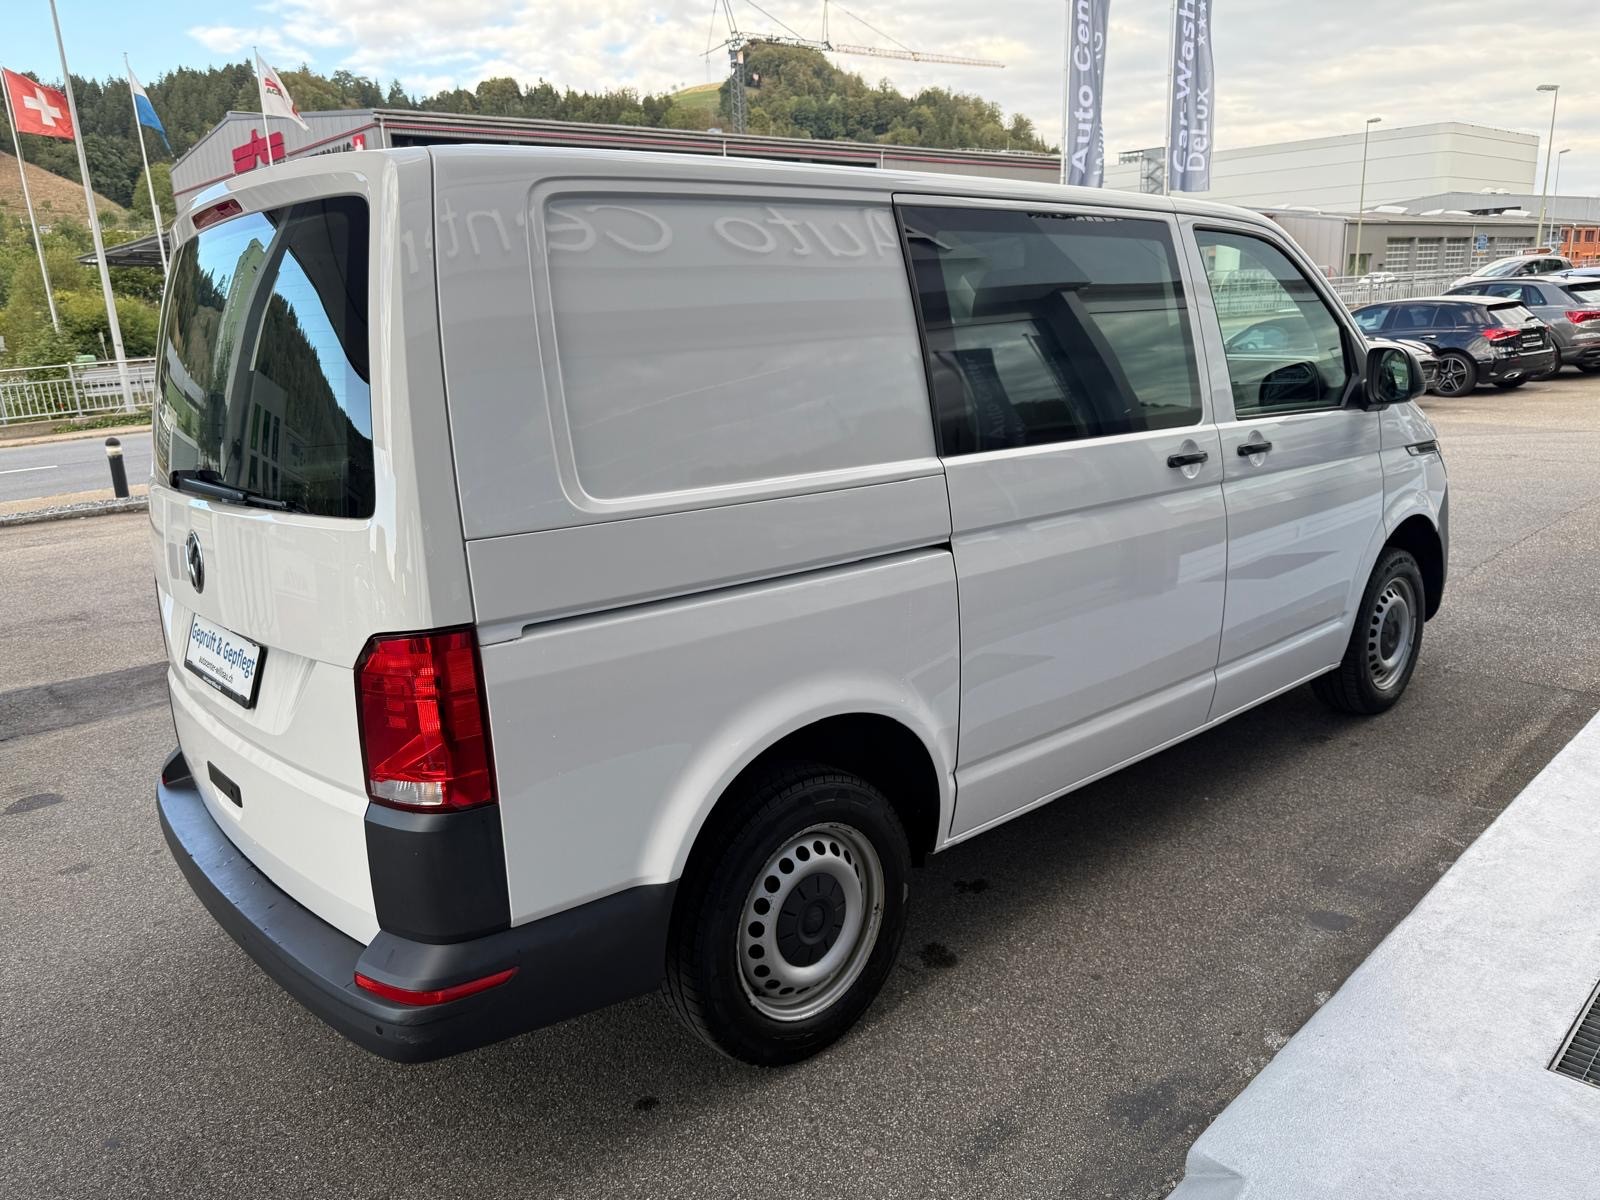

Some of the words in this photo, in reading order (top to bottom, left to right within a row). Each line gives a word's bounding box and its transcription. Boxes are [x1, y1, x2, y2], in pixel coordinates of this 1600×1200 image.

[1071, 84, 1094, 174] Auto
[1173, 0, 1195, 173] Car-Wash
[191, 622, 217, 653] Geprüft
[216, 637, 223, 656] &
[223, 642, 256, 679] Gepflegt
